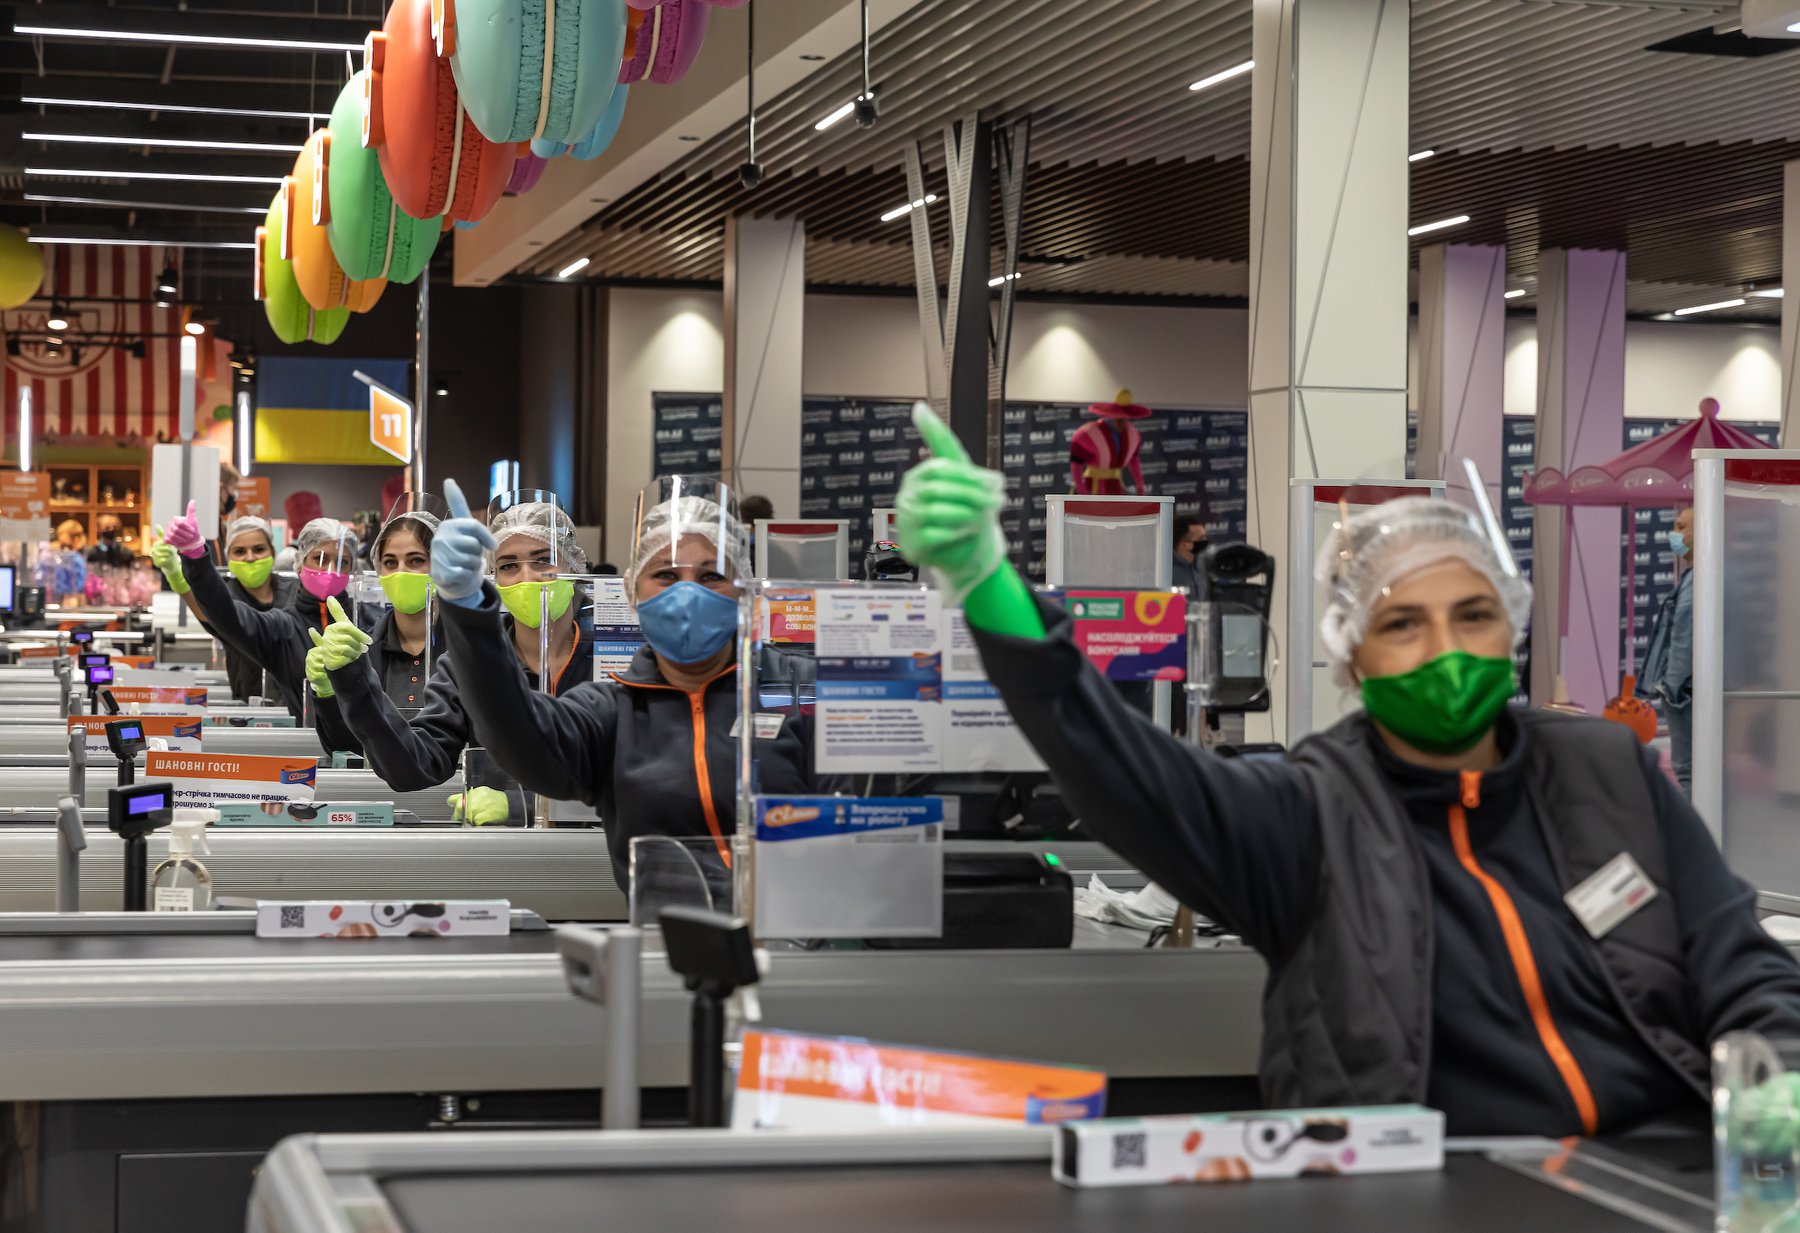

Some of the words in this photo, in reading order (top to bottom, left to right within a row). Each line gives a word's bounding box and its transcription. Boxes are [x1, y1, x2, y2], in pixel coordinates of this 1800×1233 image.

[380, 413, 402, 438] 11
[155, 759, 205, 772] ШАНОВНІ
[208, 761, 240, 773] ГОСТІ!
[212, 791, 250, 800] тимчасово
[261, 794, 291, 802] працює.
[331, 813, 353, 823] 65%
